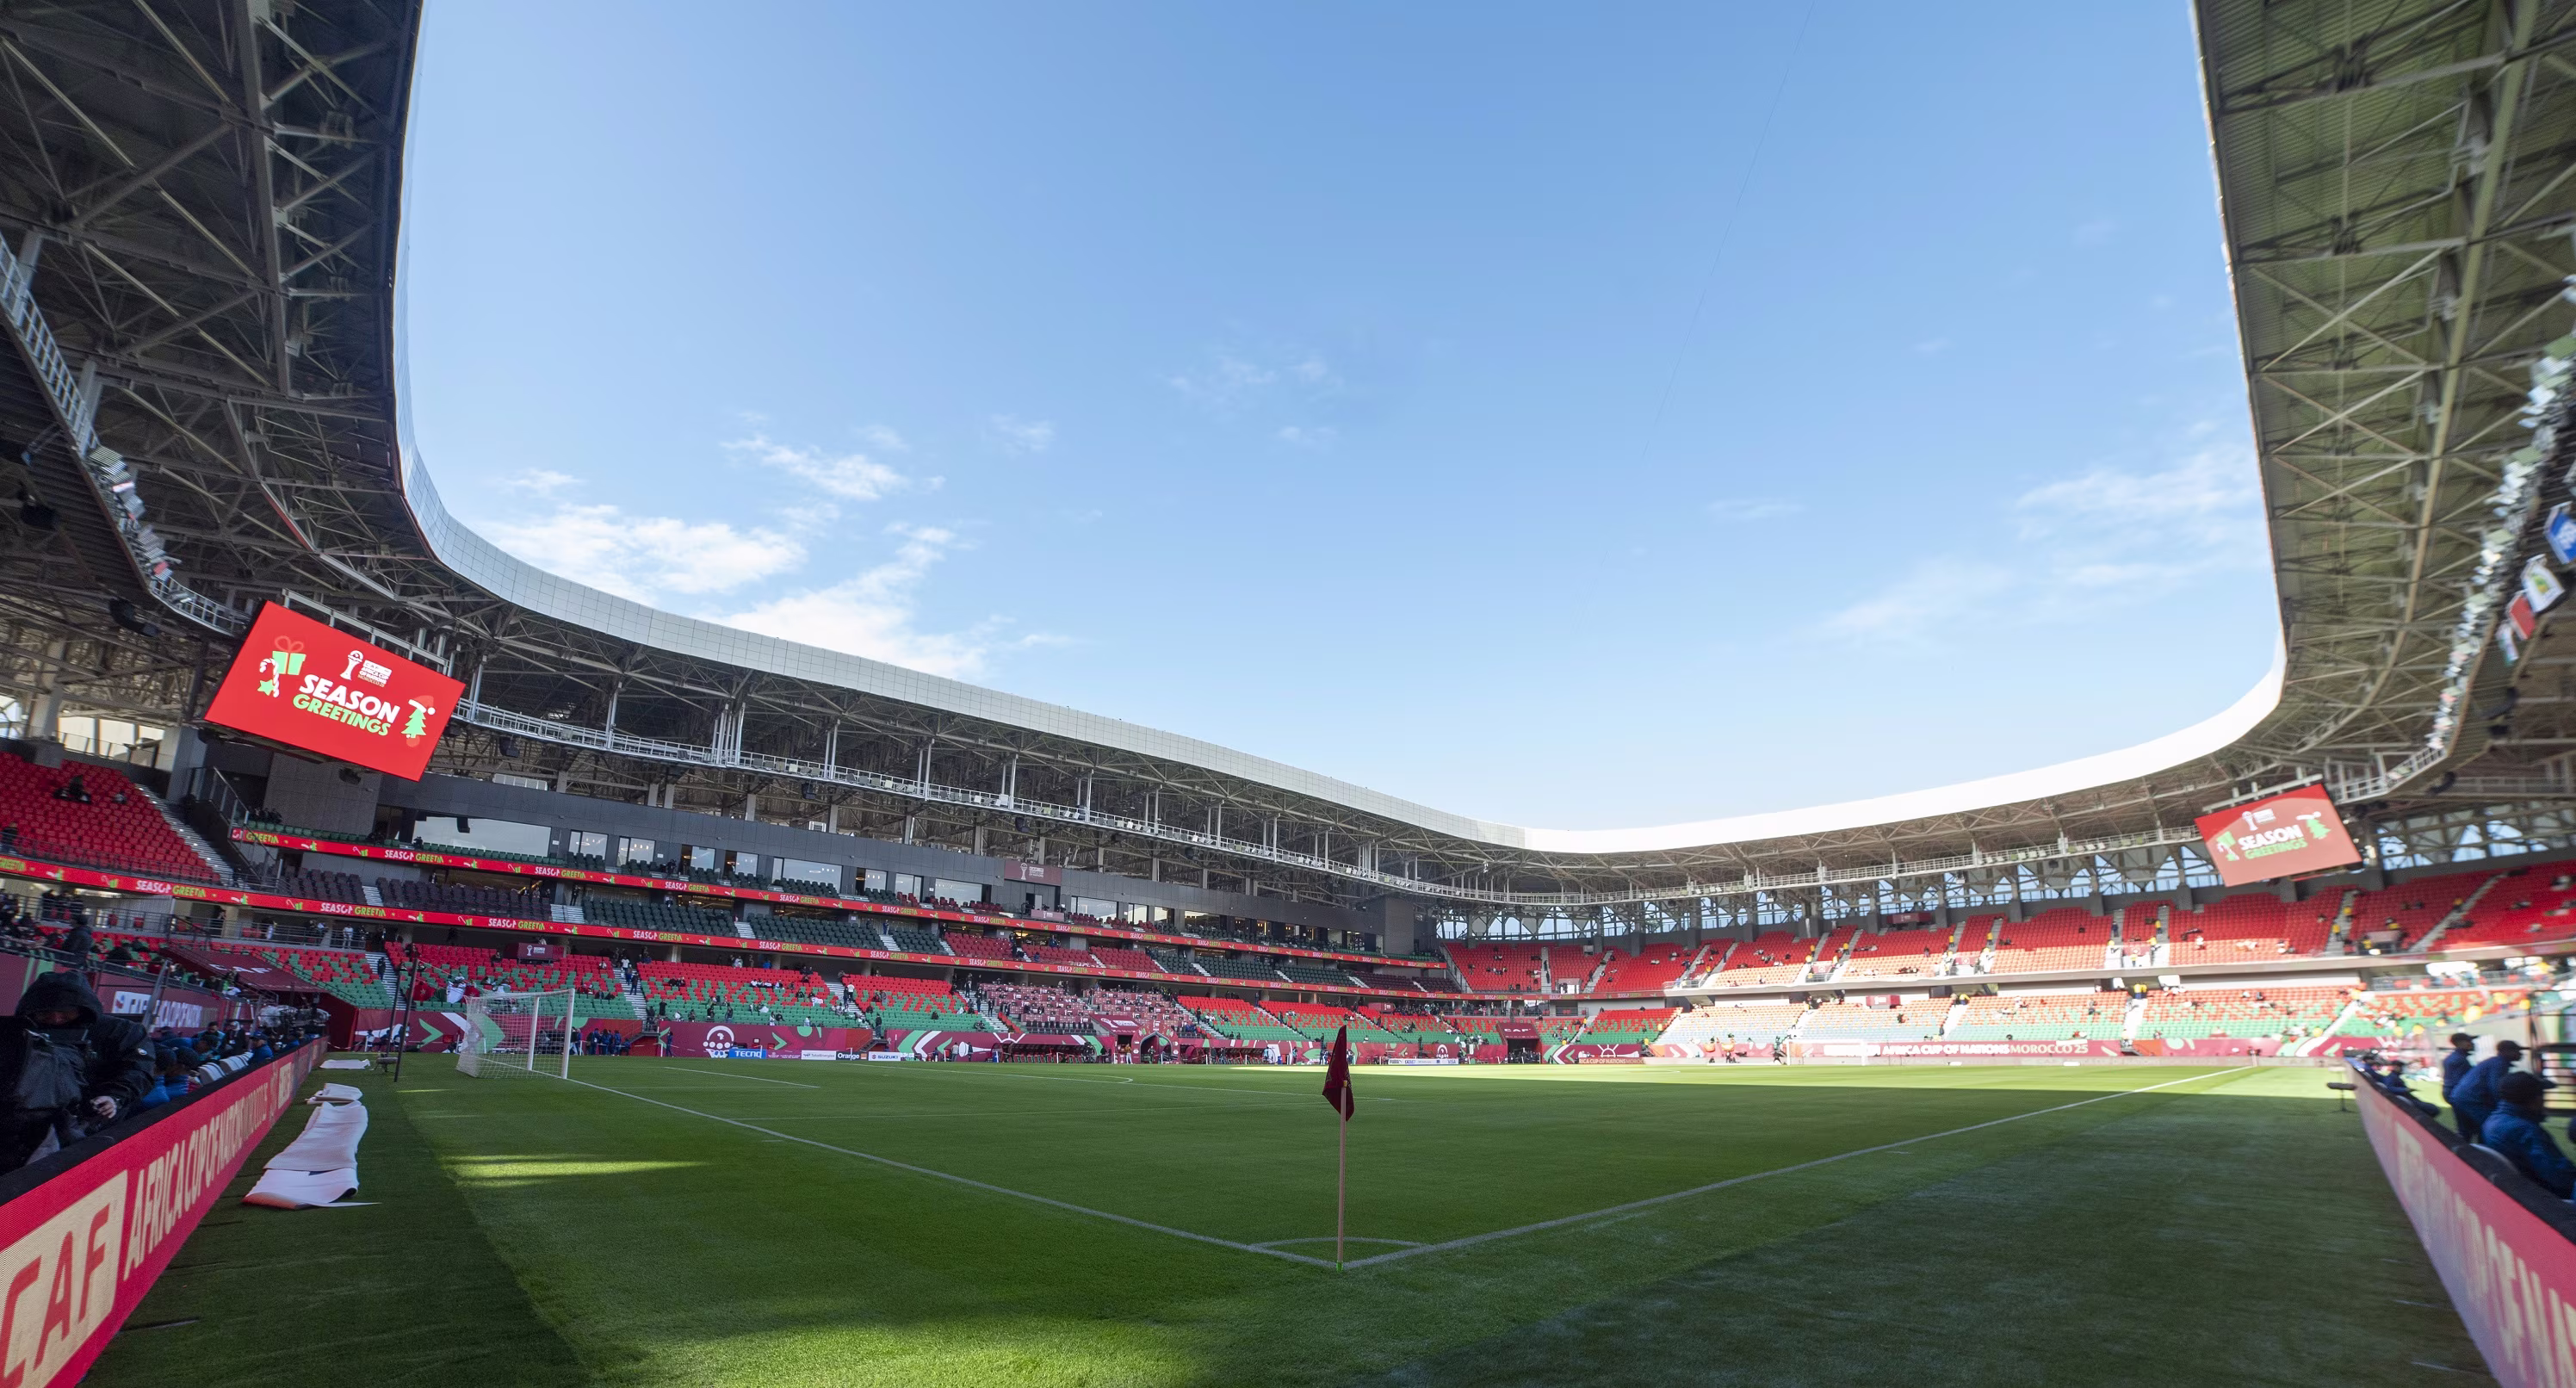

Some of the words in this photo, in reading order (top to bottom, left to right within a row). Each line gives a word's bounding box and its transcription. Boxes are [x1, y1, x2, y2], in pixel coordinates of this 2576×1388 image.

[293, 693, 391, 735] GREETINGS
[299, 674, 400, 723] SEASON
[2238, 825, 2304, 851] SEASON
[2245, 838, 2308, 859] GREETINGS
[2010, 1044, 2073, 1054] MOROCCO
[2074, 1044, 2089, 1054] 25
[0, 1202, 110, 1388] CAF
[123, 1139, 186, 1282] AFRICA
[184, 1124, 207, 1212] CUP
